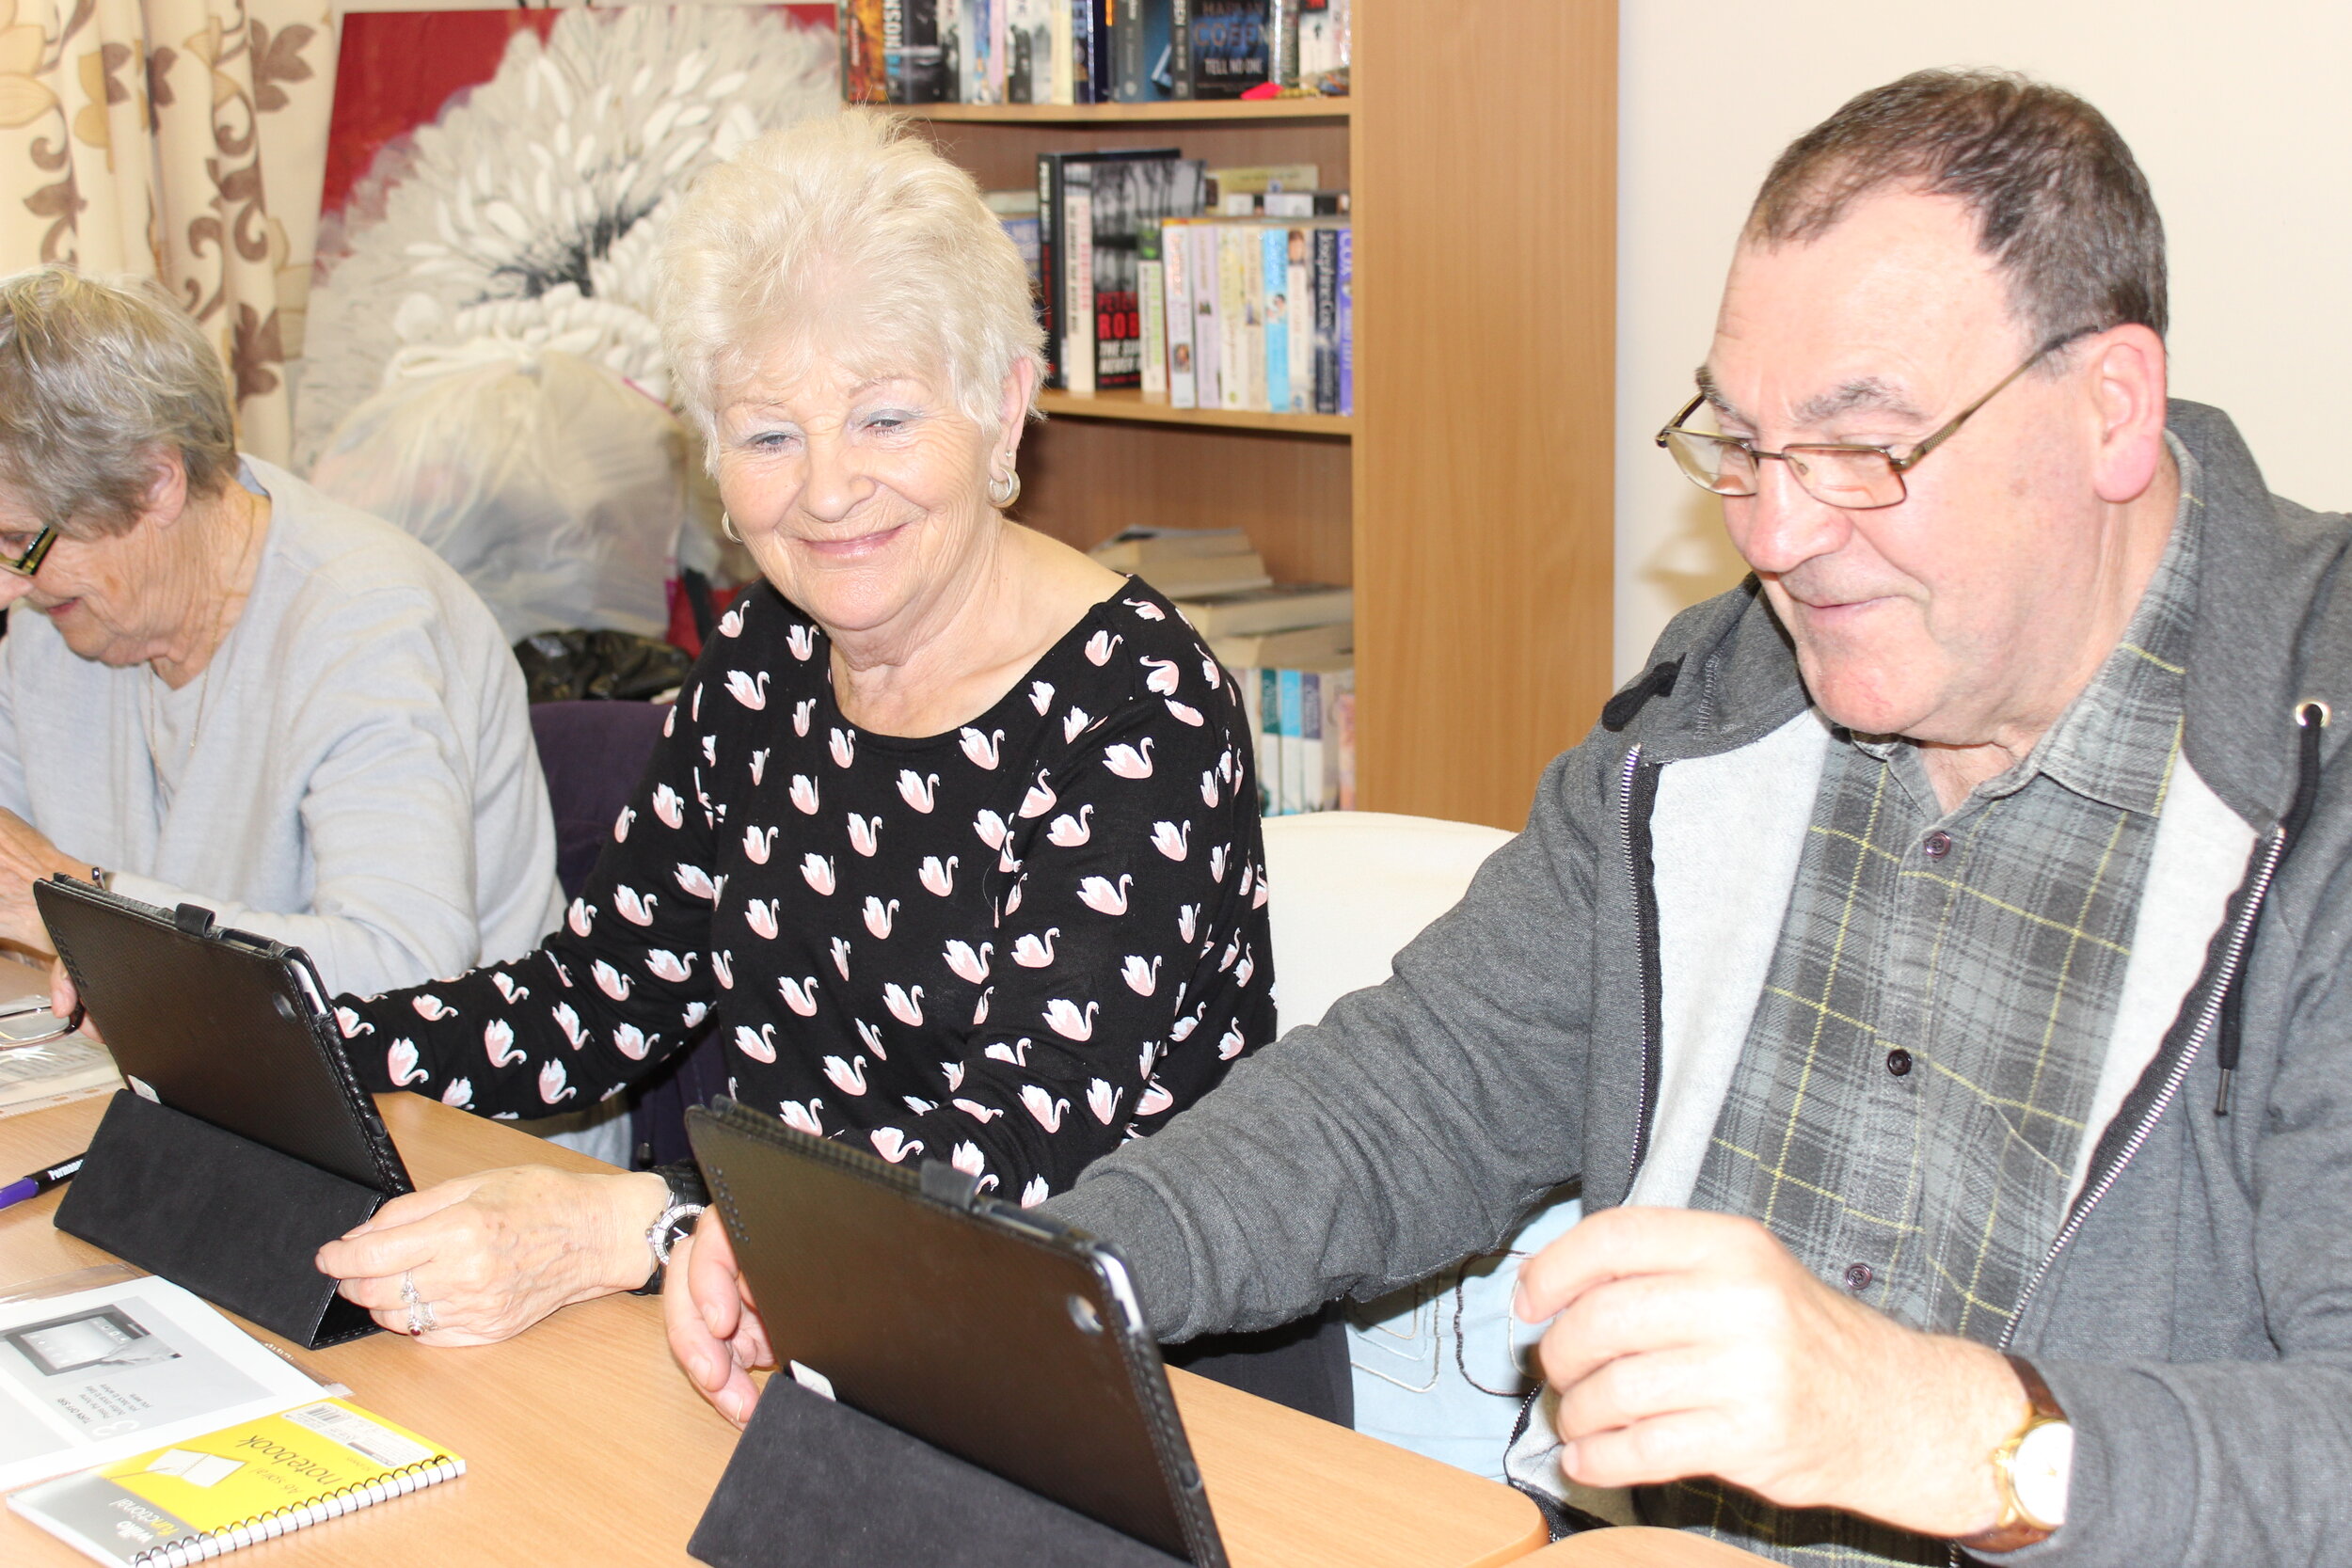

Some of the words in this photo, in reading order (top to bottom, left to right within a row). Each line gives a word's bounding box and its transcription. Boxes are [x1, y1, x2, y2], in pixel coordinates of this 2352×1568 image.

[1204, 58, 1228, 75] TELL
[1230, 58, 1245, 75] NO
[1246, 58, 1263, 74] ONE
[1315, 232, 1334, 300] Josephine
[1320, 301, 1334, 329] Cox
[92, 1419, 139, 1437] 3
[235, 1434, 342, 1488] notebook
[250, 1467, 284, 1485] spiral
[285, 1482, 302, 1496] A6
[108, 1497, 179, 1538] functional
[116, 1520, 153, 1544] wilko
